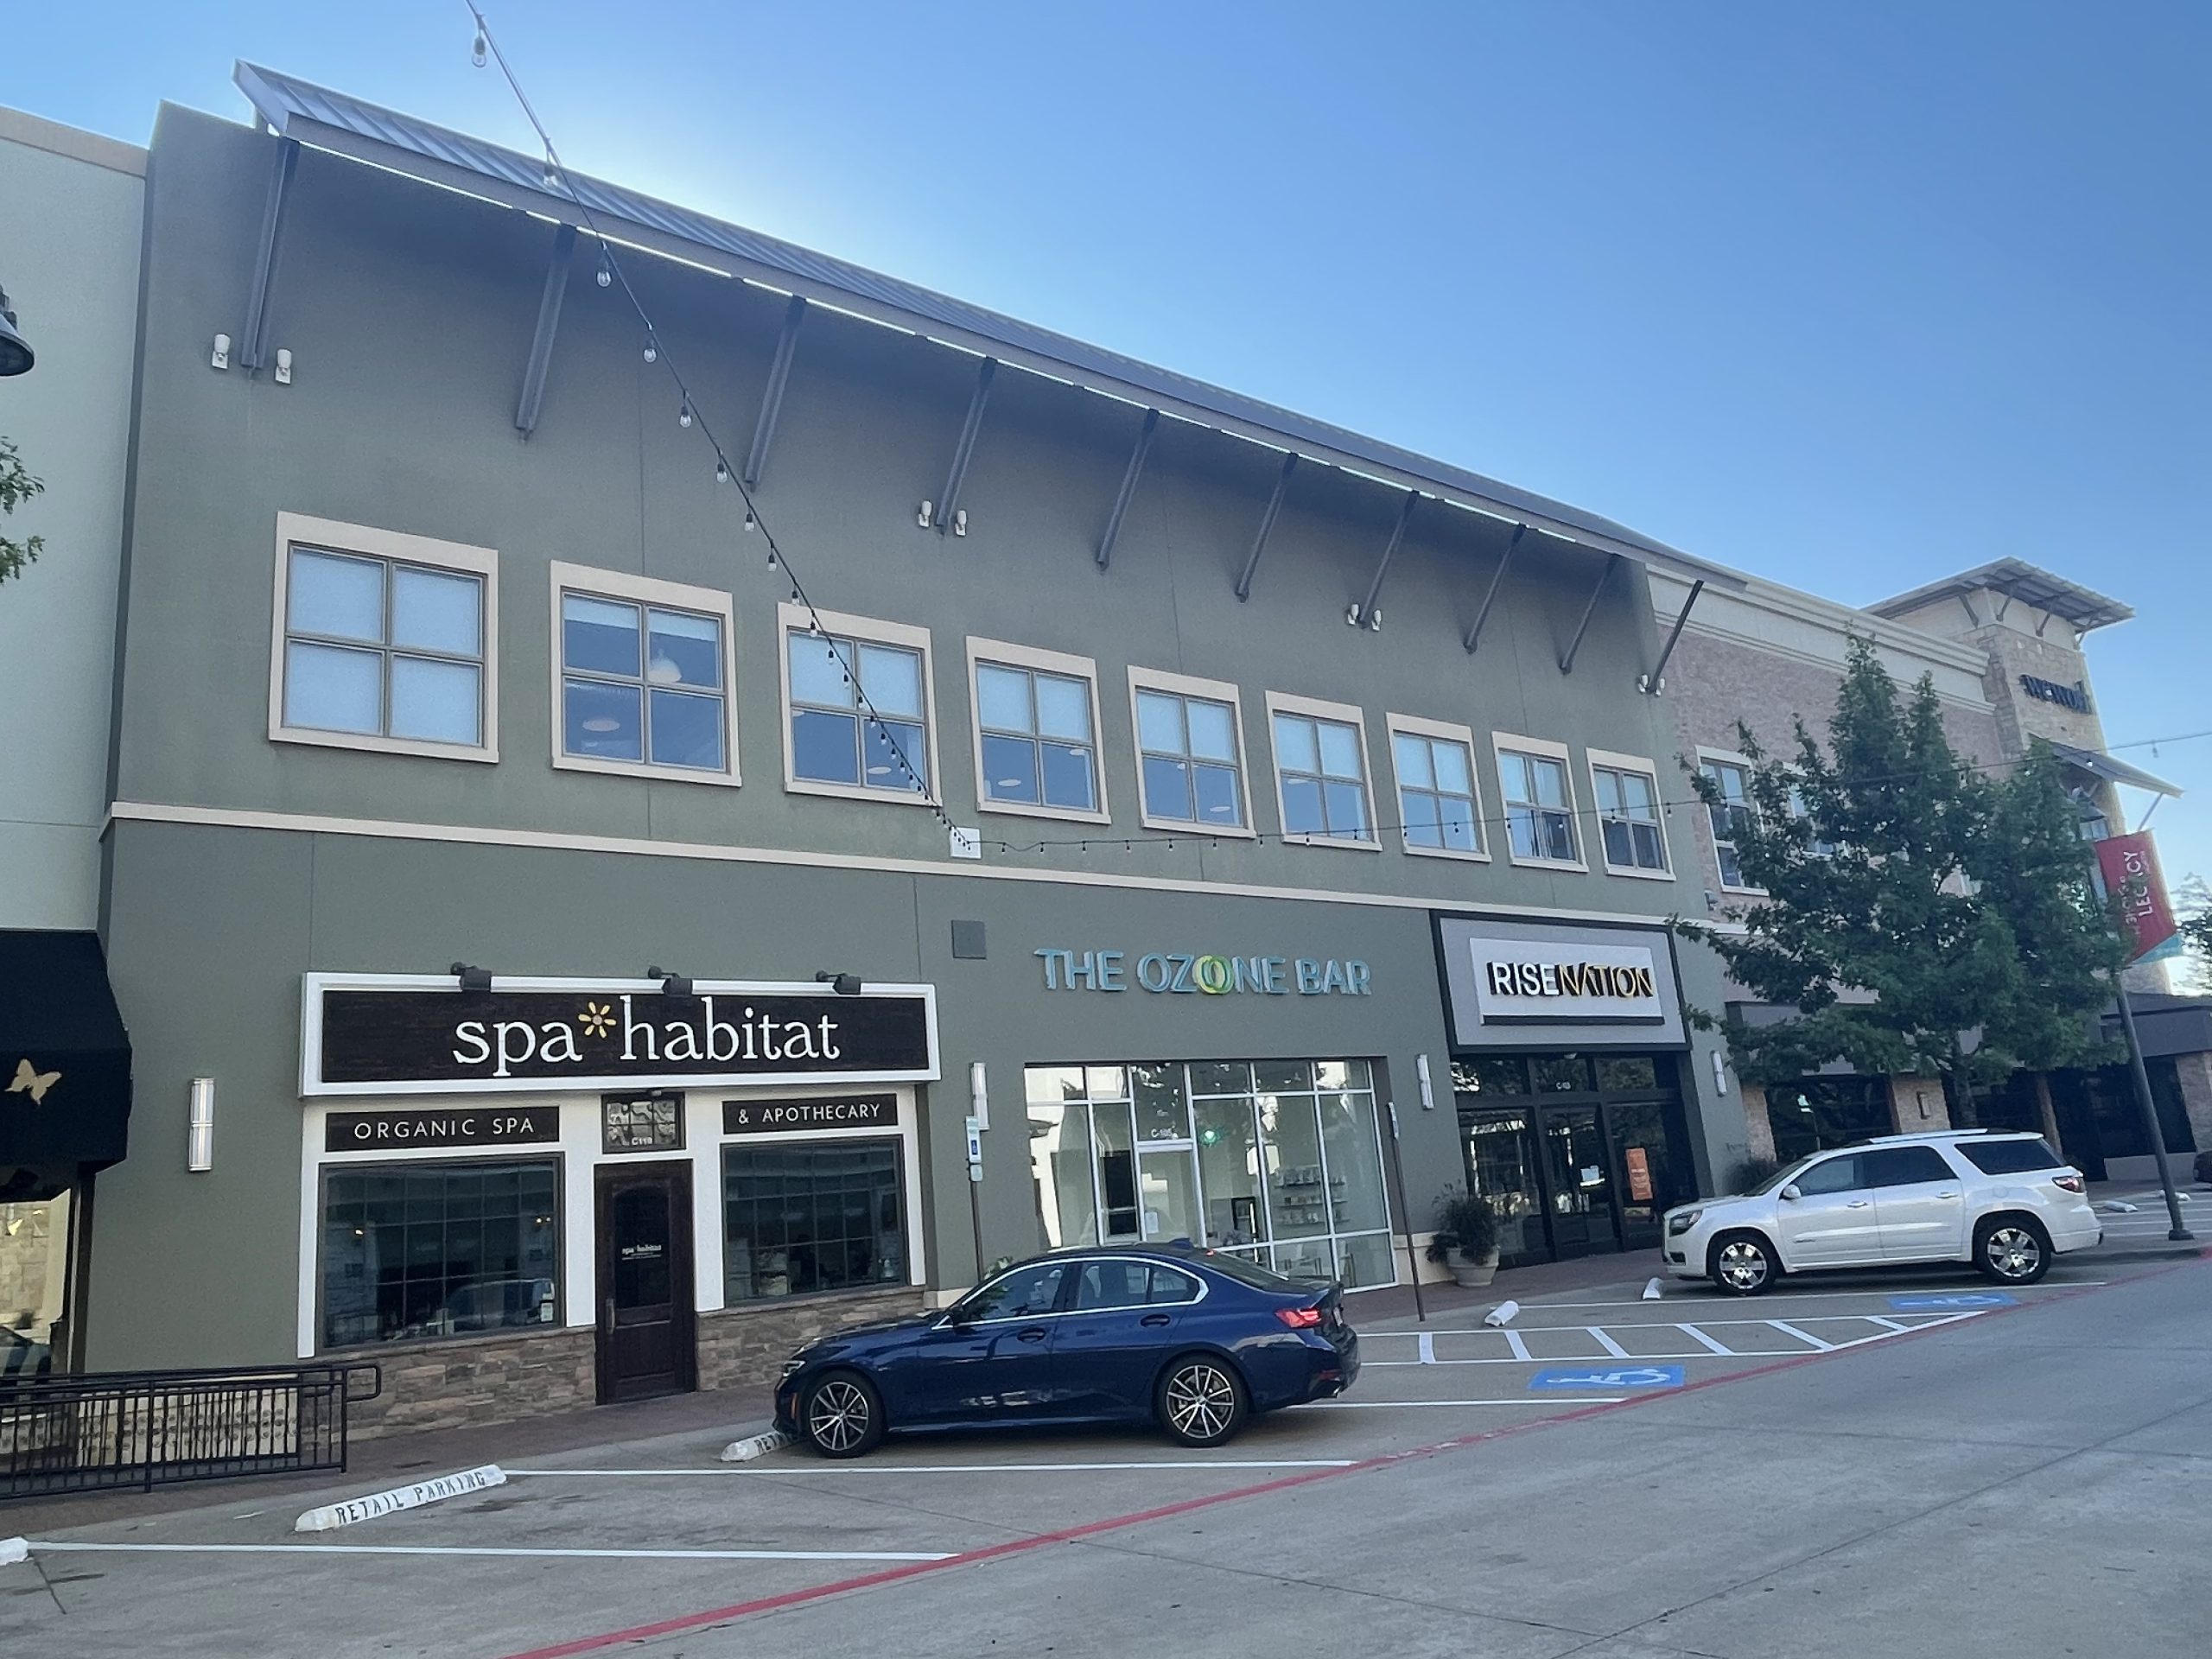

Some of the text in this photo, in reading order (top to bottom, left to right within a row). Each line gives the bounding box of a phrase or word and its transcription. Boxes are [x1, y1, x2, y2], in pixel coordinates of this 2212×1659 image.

[1033, 949, 1372, 995] THE OZONE BAR
[453, 995, 841, 1076] spa habitat
[353, 1118, 535, 1140] ORGANIC SPA
[739, 1103, 880, 1123] & APOTHECARY
[335, 1471, 486, 1524] RETAIL PARKING
